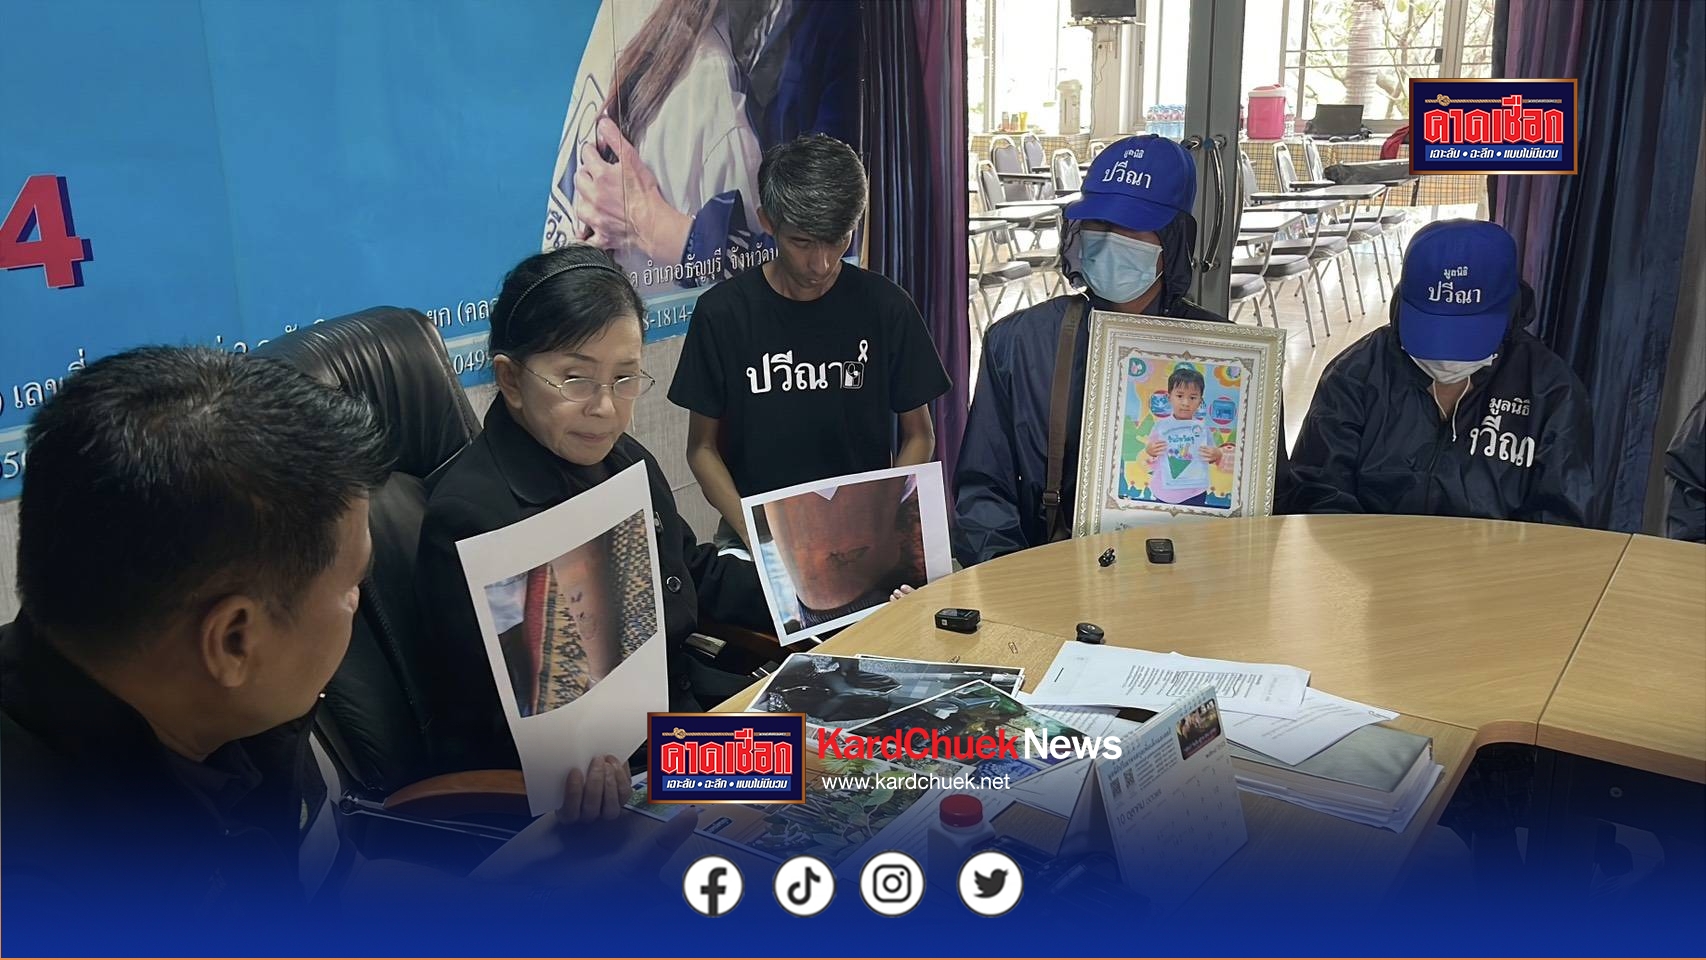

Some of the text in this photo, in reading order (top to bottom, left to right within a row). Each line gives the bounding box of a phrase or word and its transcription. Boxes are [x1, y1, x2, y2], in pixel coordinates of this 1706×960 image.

[1102, 160, 1152, 189] ปวีณา
[0, 172, 94, 290] 4
[643, 247, 722, 286] อำเภอธัญบุรี
[1428, 280, 1481, 304] ปวีณา
[746, 350, 843, 394] ปวีณา
[1489, 397, 1531, 417] มูลนิธิ
